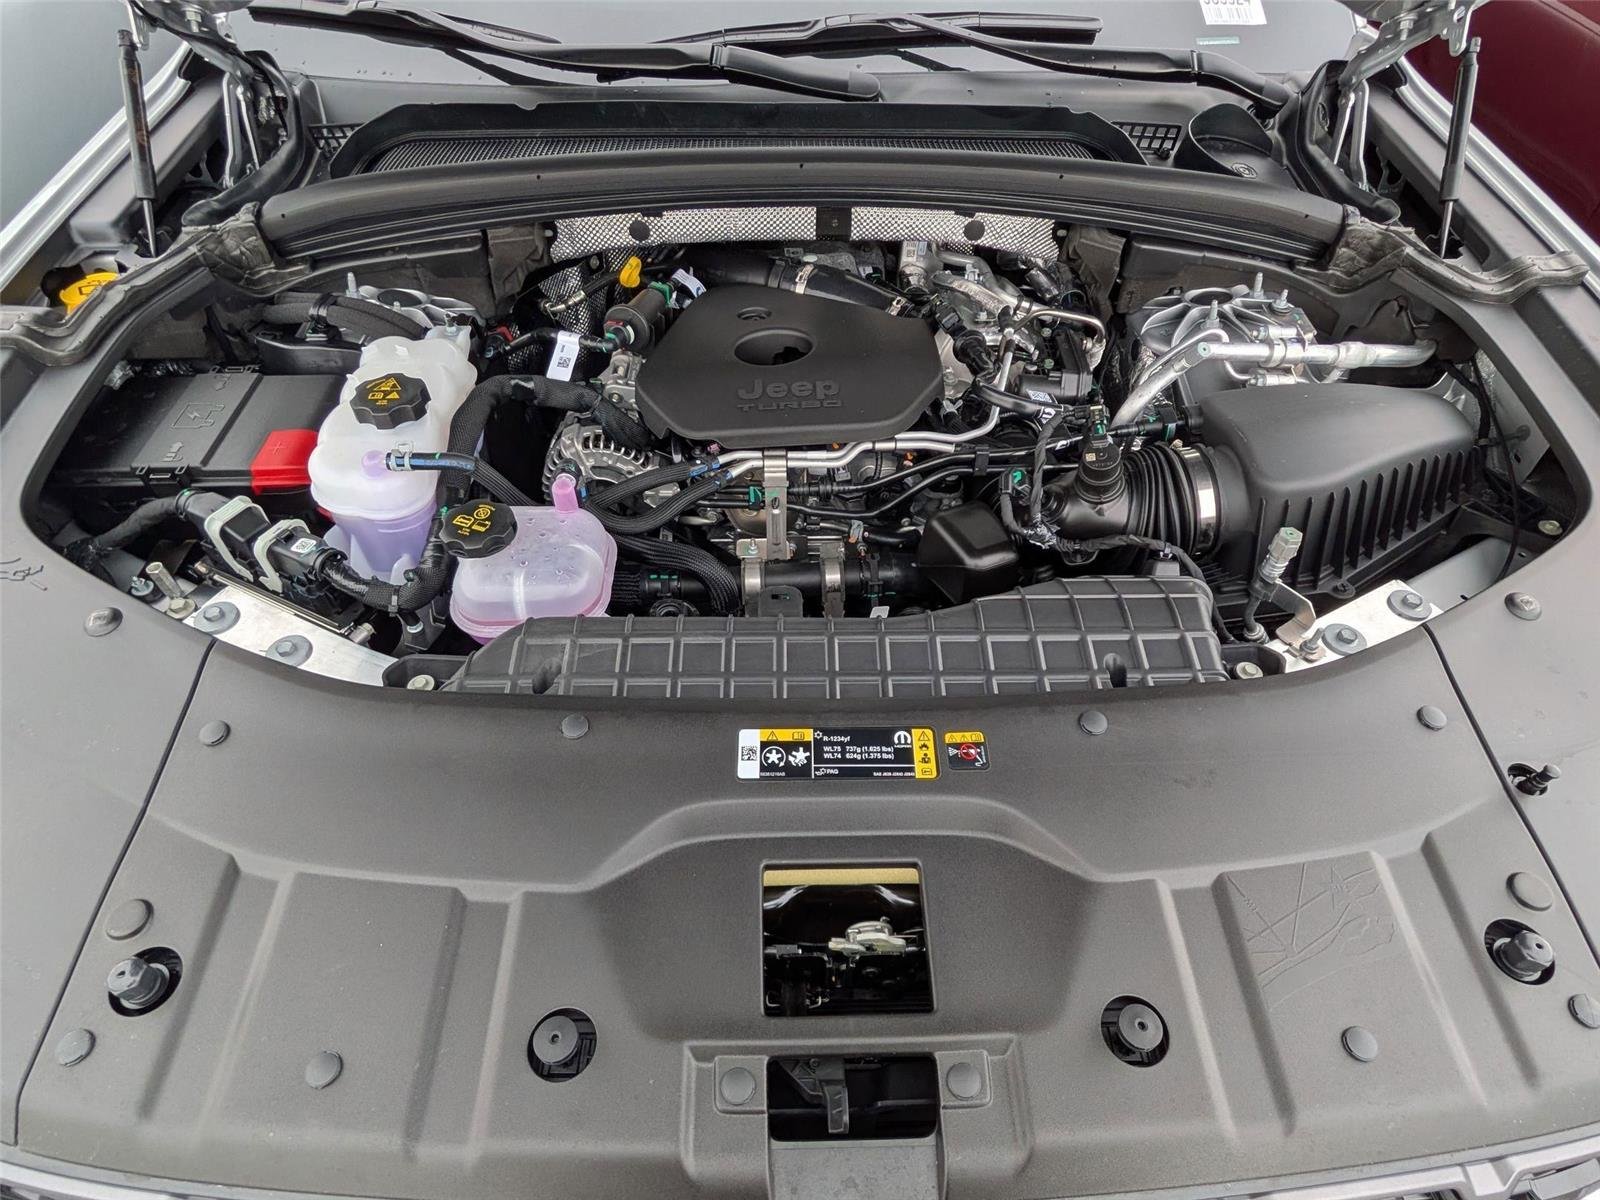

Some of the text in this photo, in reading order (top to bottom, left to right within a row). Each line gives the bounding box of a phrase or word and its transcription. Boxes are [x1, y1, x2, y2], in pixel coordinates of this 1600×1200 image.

[738, 379, 840, 400] Jeep
[737, 400, 842, 412] TURBO
[823, 735, 850, 743] R-1234yf
[881, 745, 894, 753] lbs)
